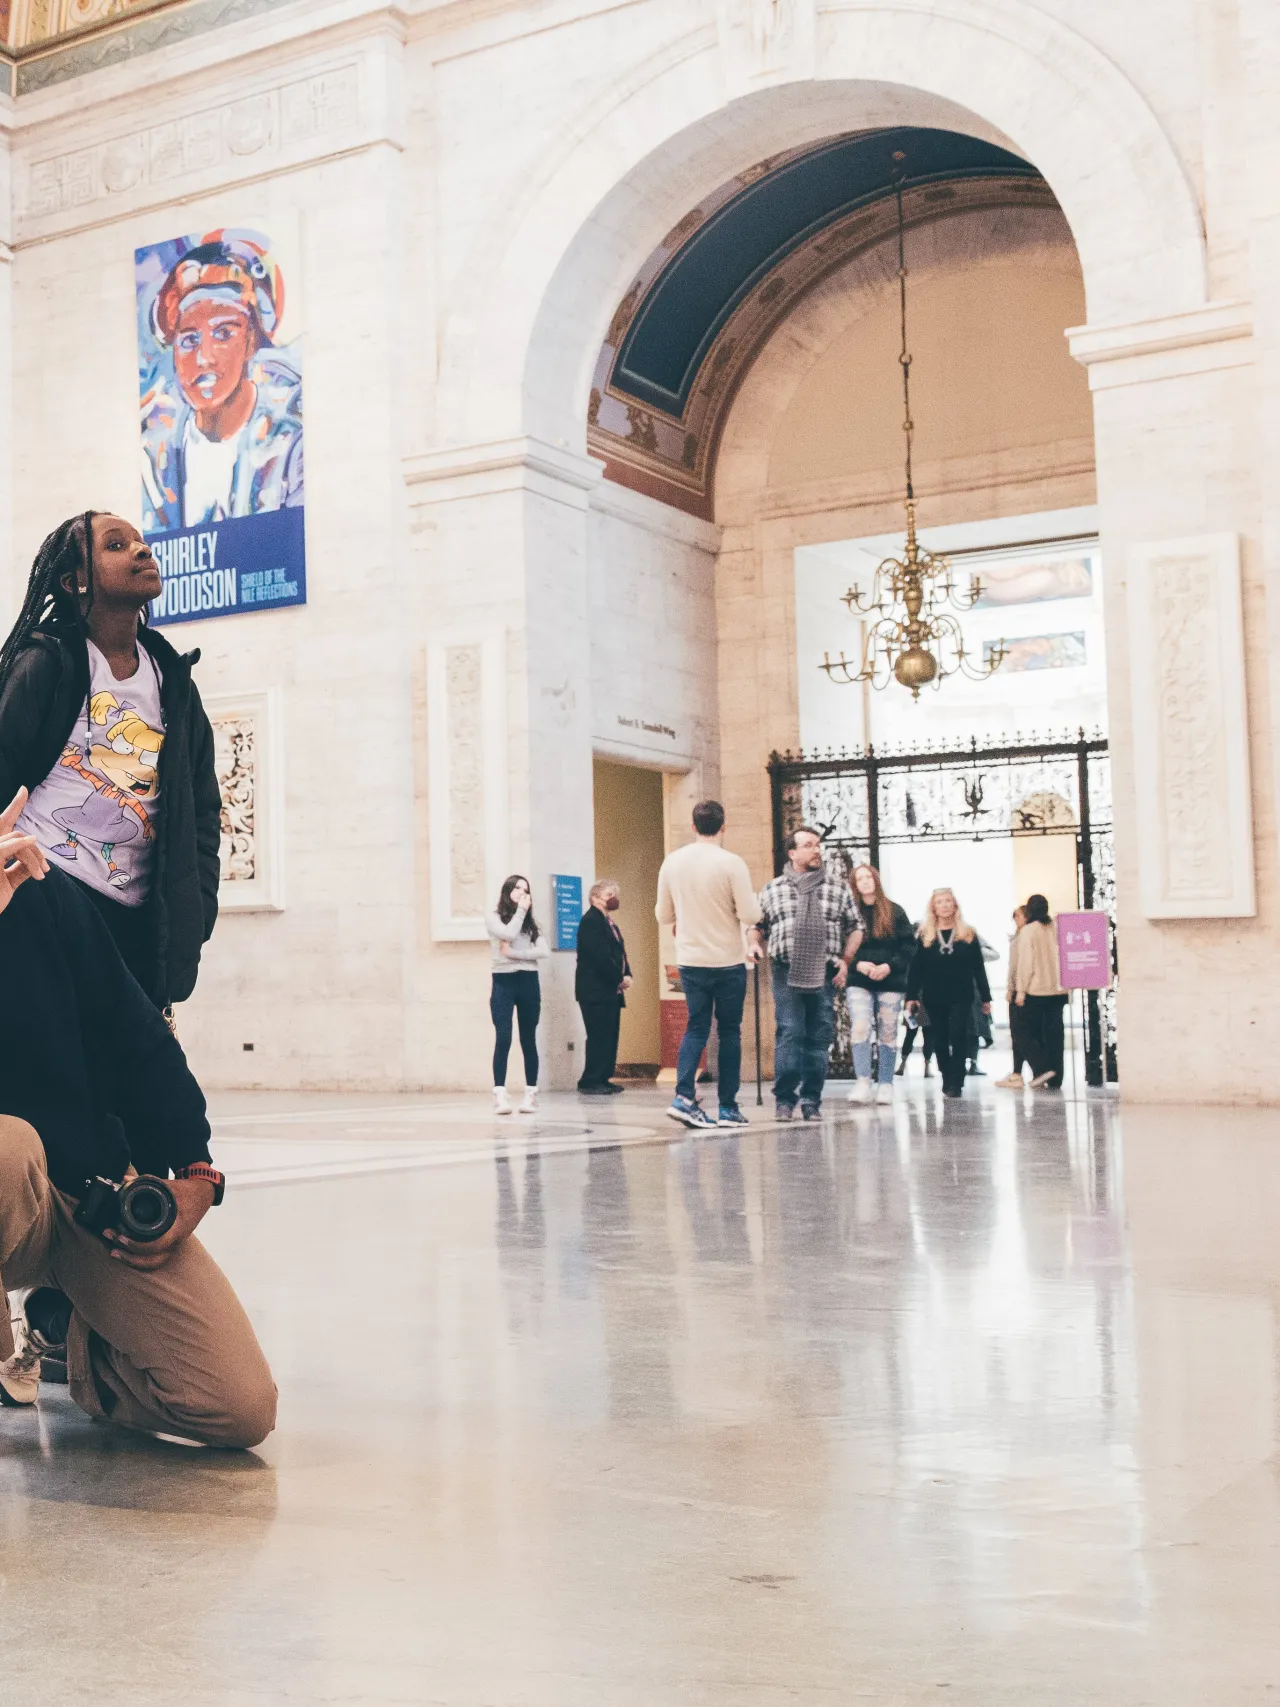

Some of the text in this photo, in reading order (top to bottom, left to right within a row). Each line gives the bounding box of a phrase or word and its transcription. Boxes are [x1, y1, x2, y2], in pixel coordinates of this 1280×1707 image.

[151, 531, 218, 578] SHIRLEY
[152, 567, 237, 618] WOODSON
[240, 567, 286, 589] SHIELD OF THE
[241, 581, 298, 603] NILE REFLECTIONS
